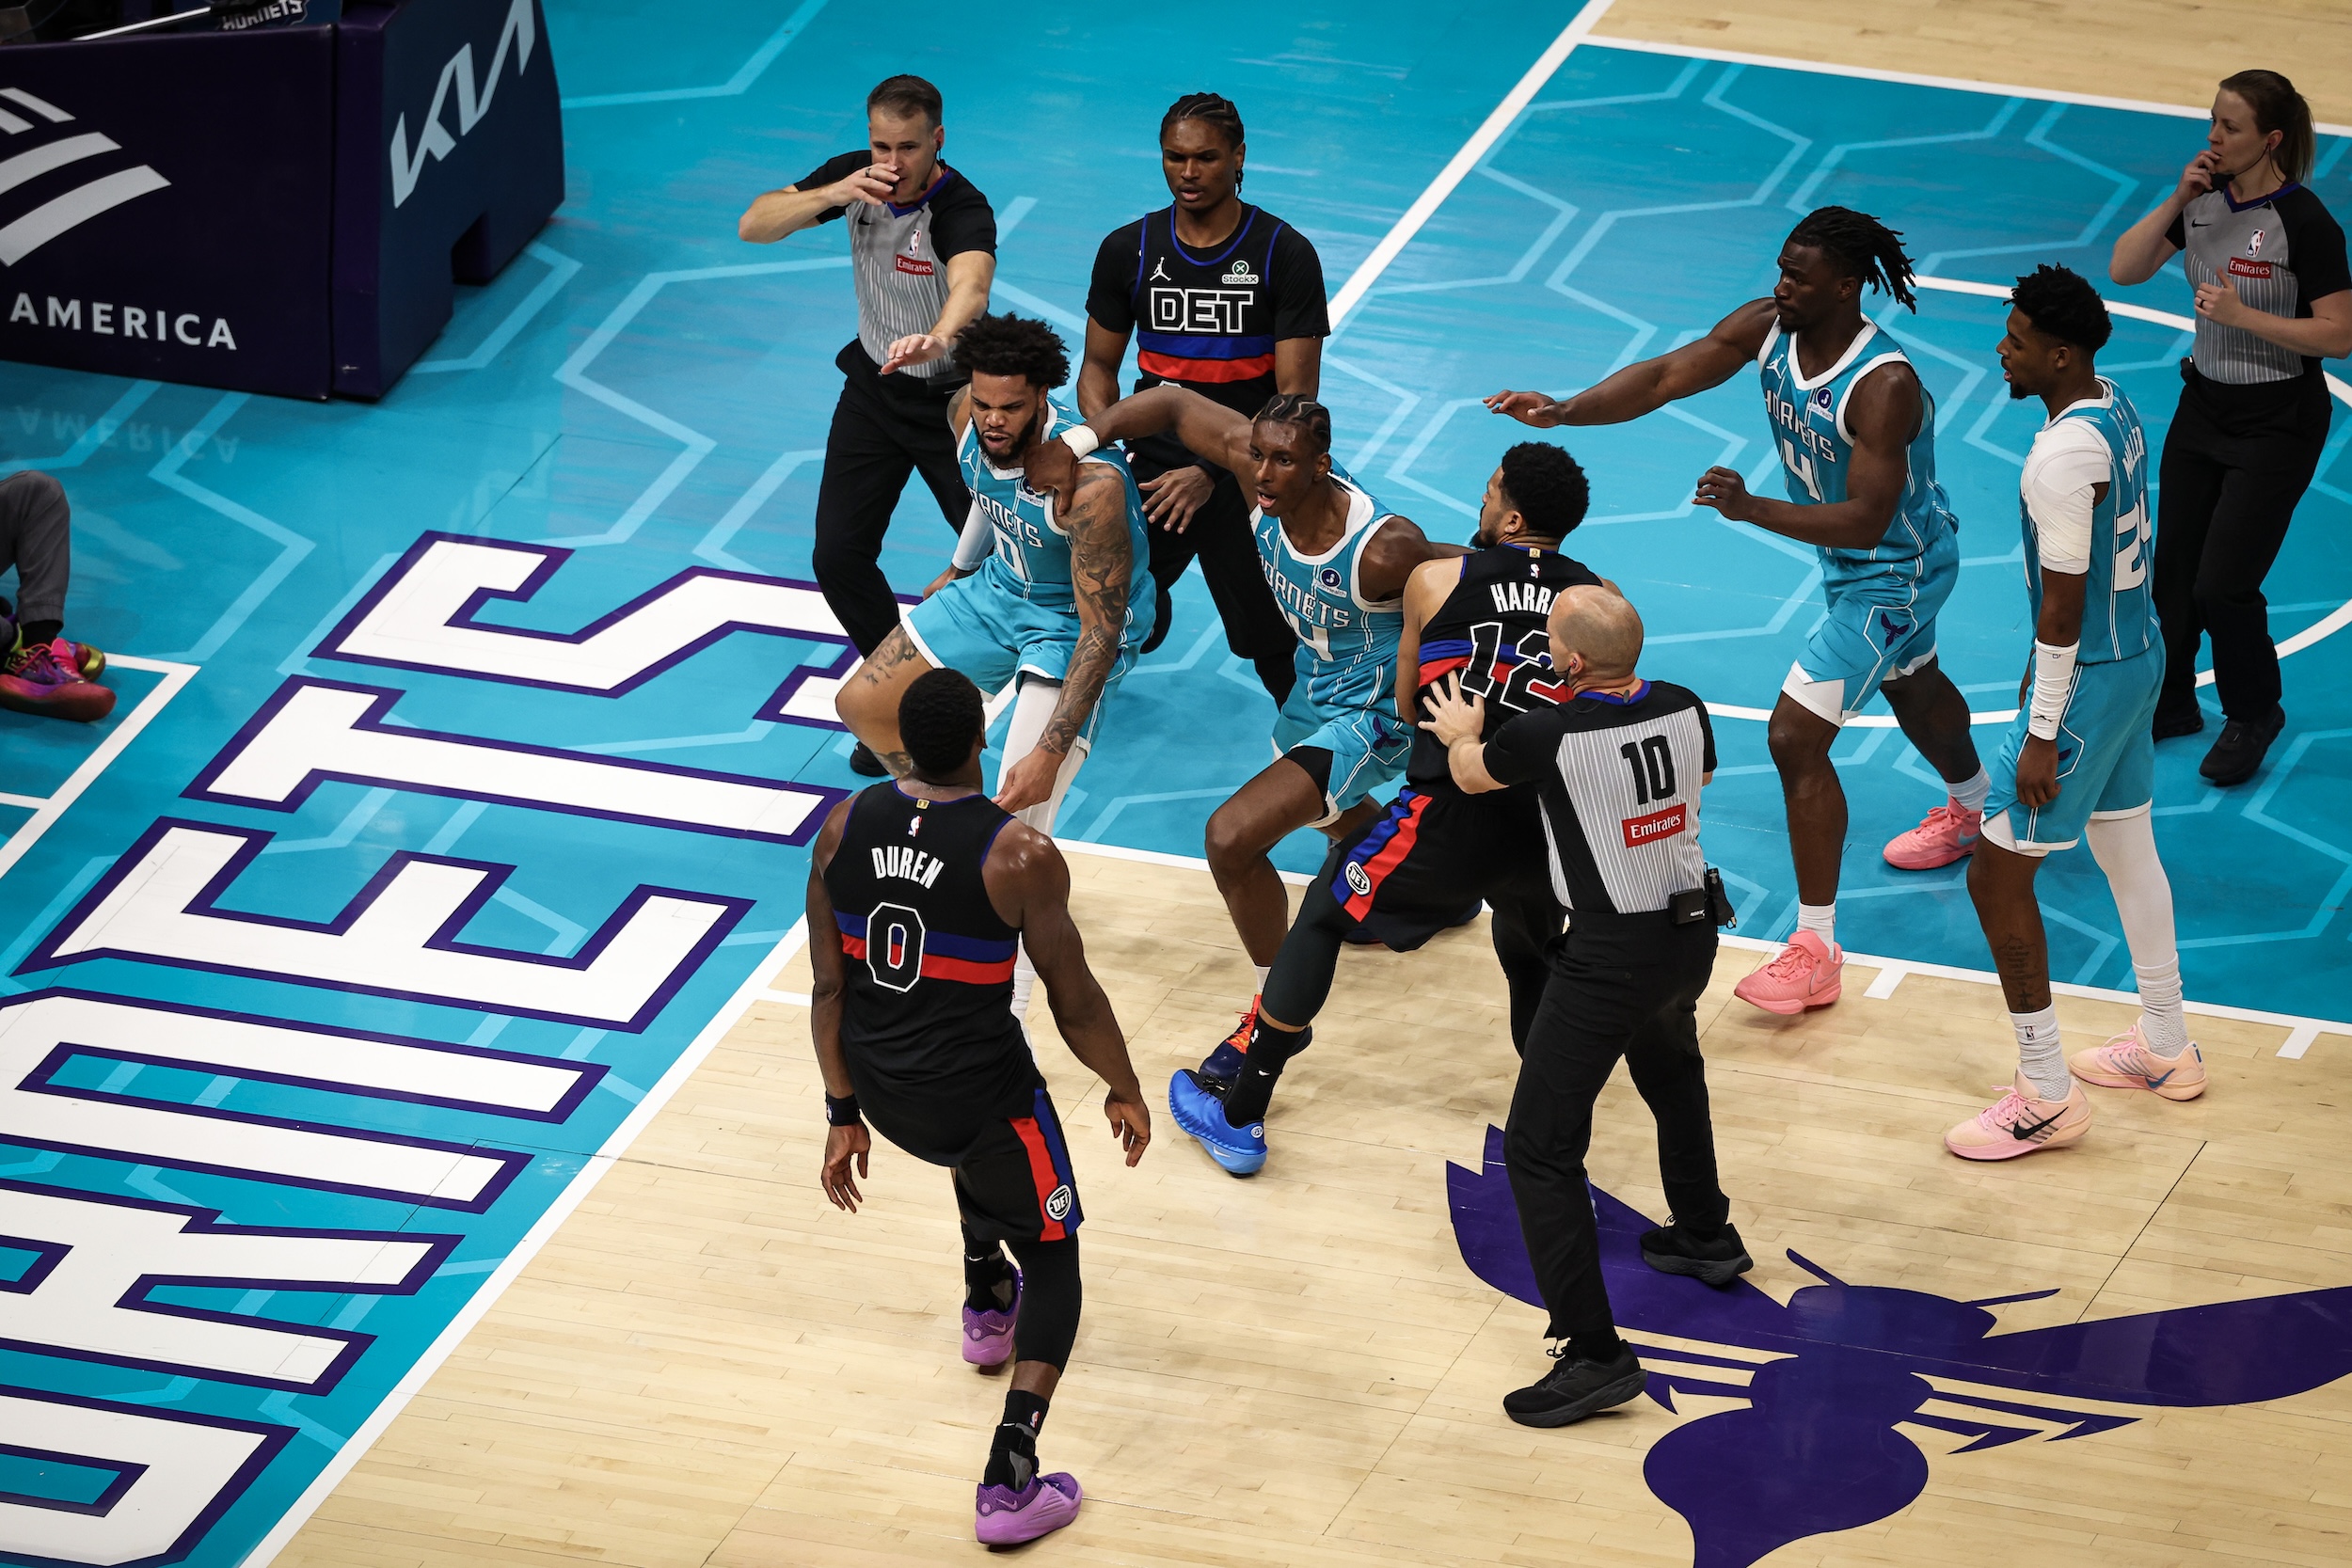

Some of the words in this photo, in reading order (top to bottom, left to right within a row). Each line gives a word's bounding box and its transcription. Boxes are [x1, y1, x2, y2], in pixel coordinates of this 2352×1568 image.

[898, 257, 932, 273] Emirates
[1223, 275, 1257, 283] StockX
[2230, 261, 2270, 276] Emirates
[9, 293, 237, 351] AMERICA
[1151, 287, 1254, 333] DET
[1783, 438, 1820, 501] 4
[991, 521, 1026, 581] 0
[1459, 621, 1565, 714] 12
[1620, 735, 1676, 805] 10
[1630, 814, 1681, 839] Emirates
[871, 846, 946, 890] DUREN
[1348, 865, 1366, 889] DET
[866, 901, 926, 993] 0
[1052, 1192, 1070, 1212] DET
